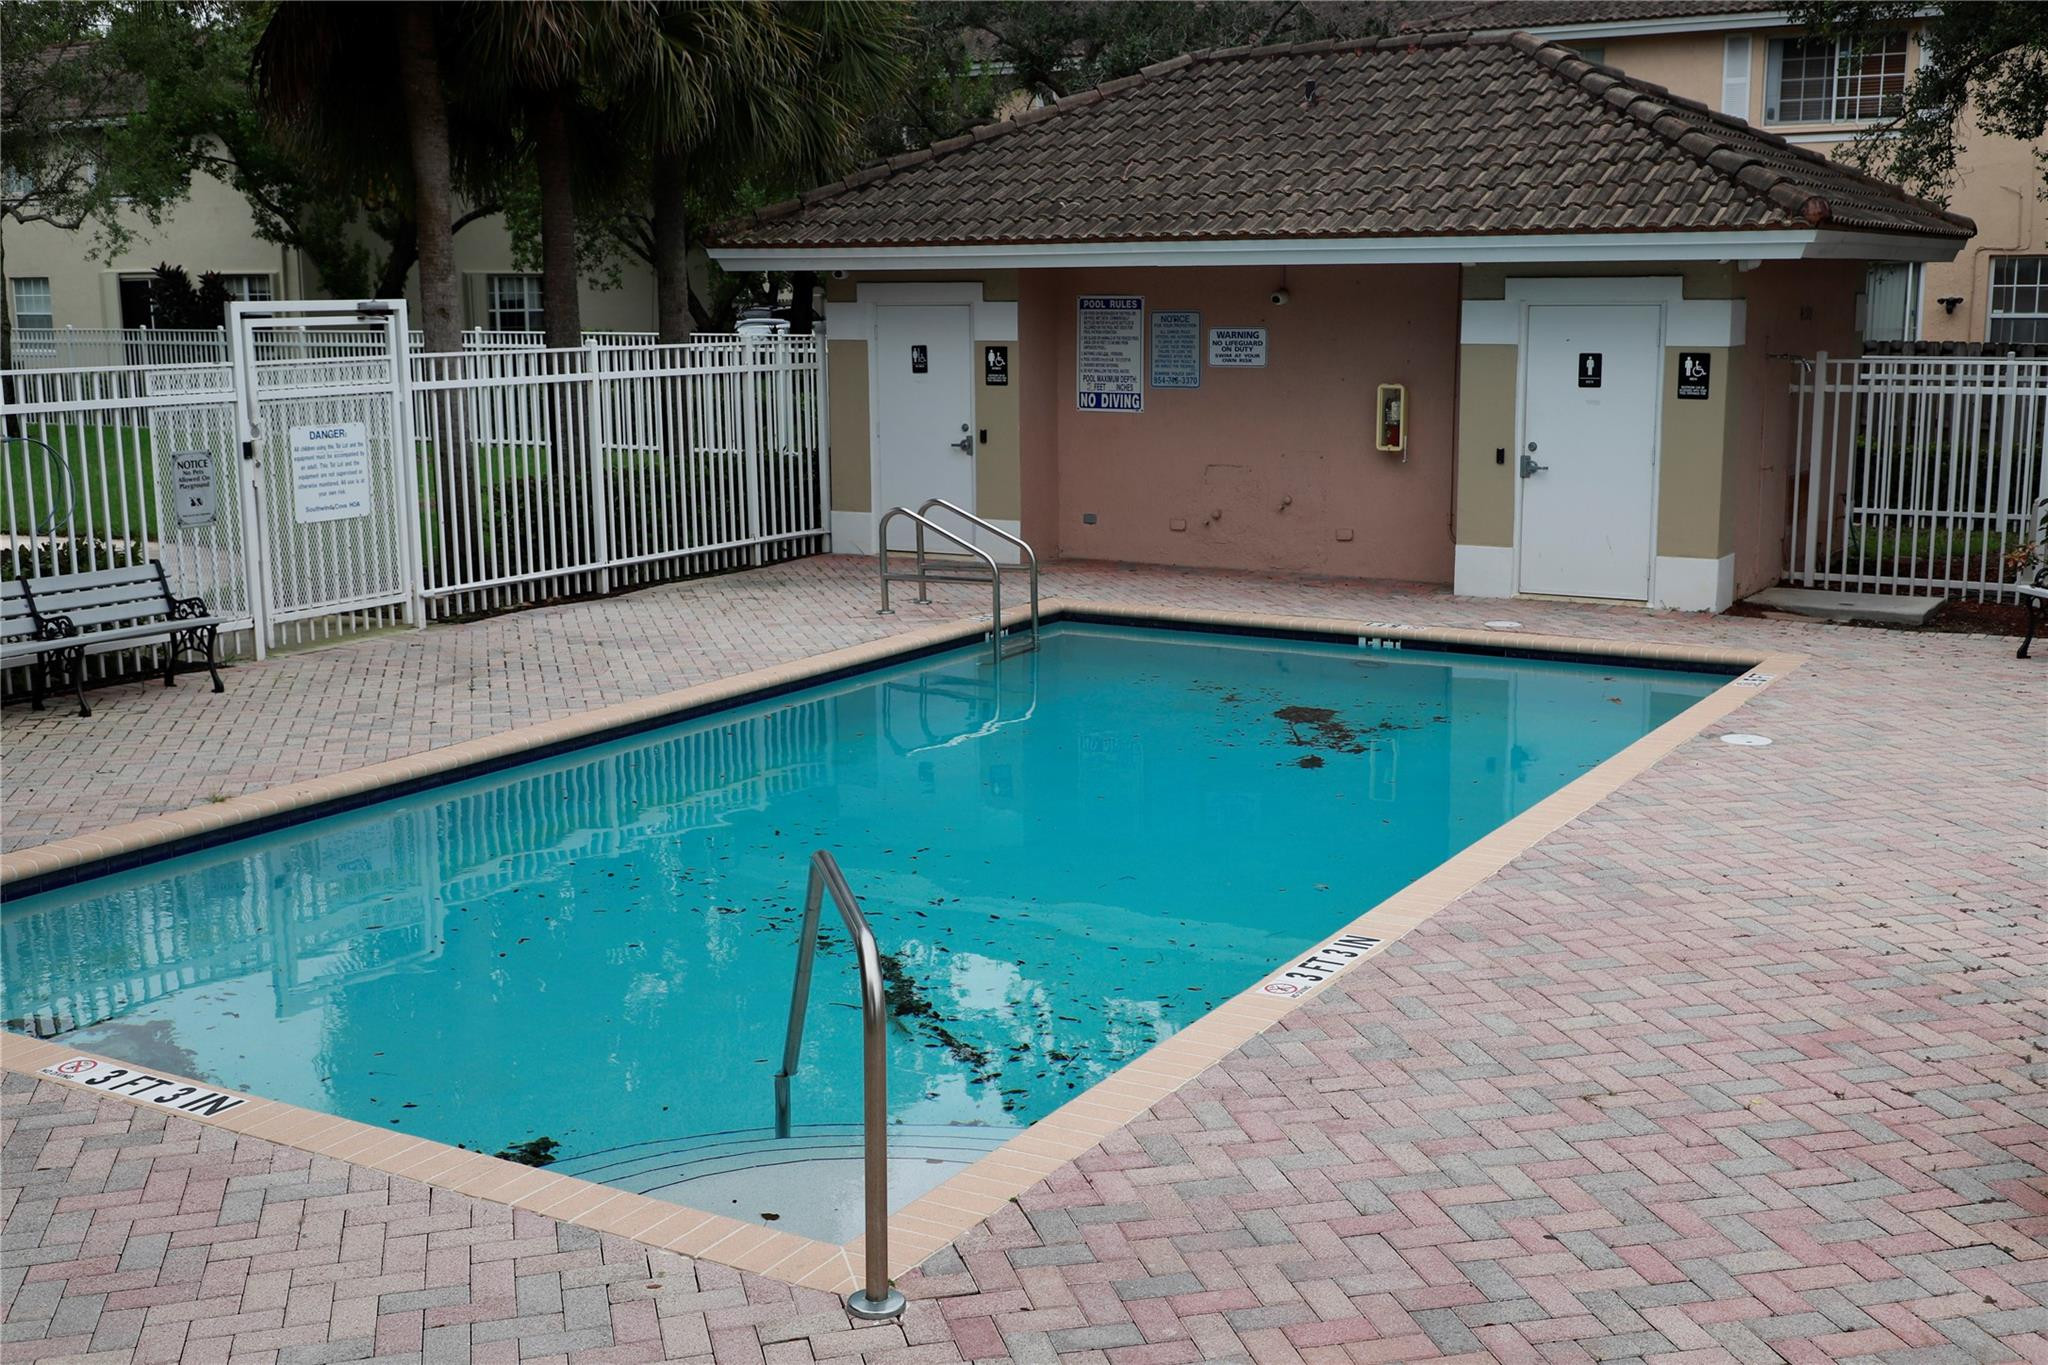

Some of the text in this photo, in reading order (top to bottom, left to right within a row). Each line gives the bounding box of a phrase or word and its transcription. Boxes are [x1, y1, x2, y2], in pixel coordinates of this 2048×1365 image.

[1083, 300, 1138, 309] POOL RULES
[1160, 315, 1191, 323] NOTICE
[1216, 331, 1260, 339] WARNING
[1083, 374, 1096, 382] POOL
[1097, 375, 1120, 383] MAXIMUM
[1094, 383, 1106, 391] FEET
[1080, 393, 1140, 408] NO DIVING
[177, 460, 208, 469] NOTICE
[179, 475, 200, 483] Allowed
[179, 481, 210, 490] Playground
[1285, 934, 1381, 982] 3 FT 3 IN
[85, 1069, 244, 1117] 3 FT 3 IN
